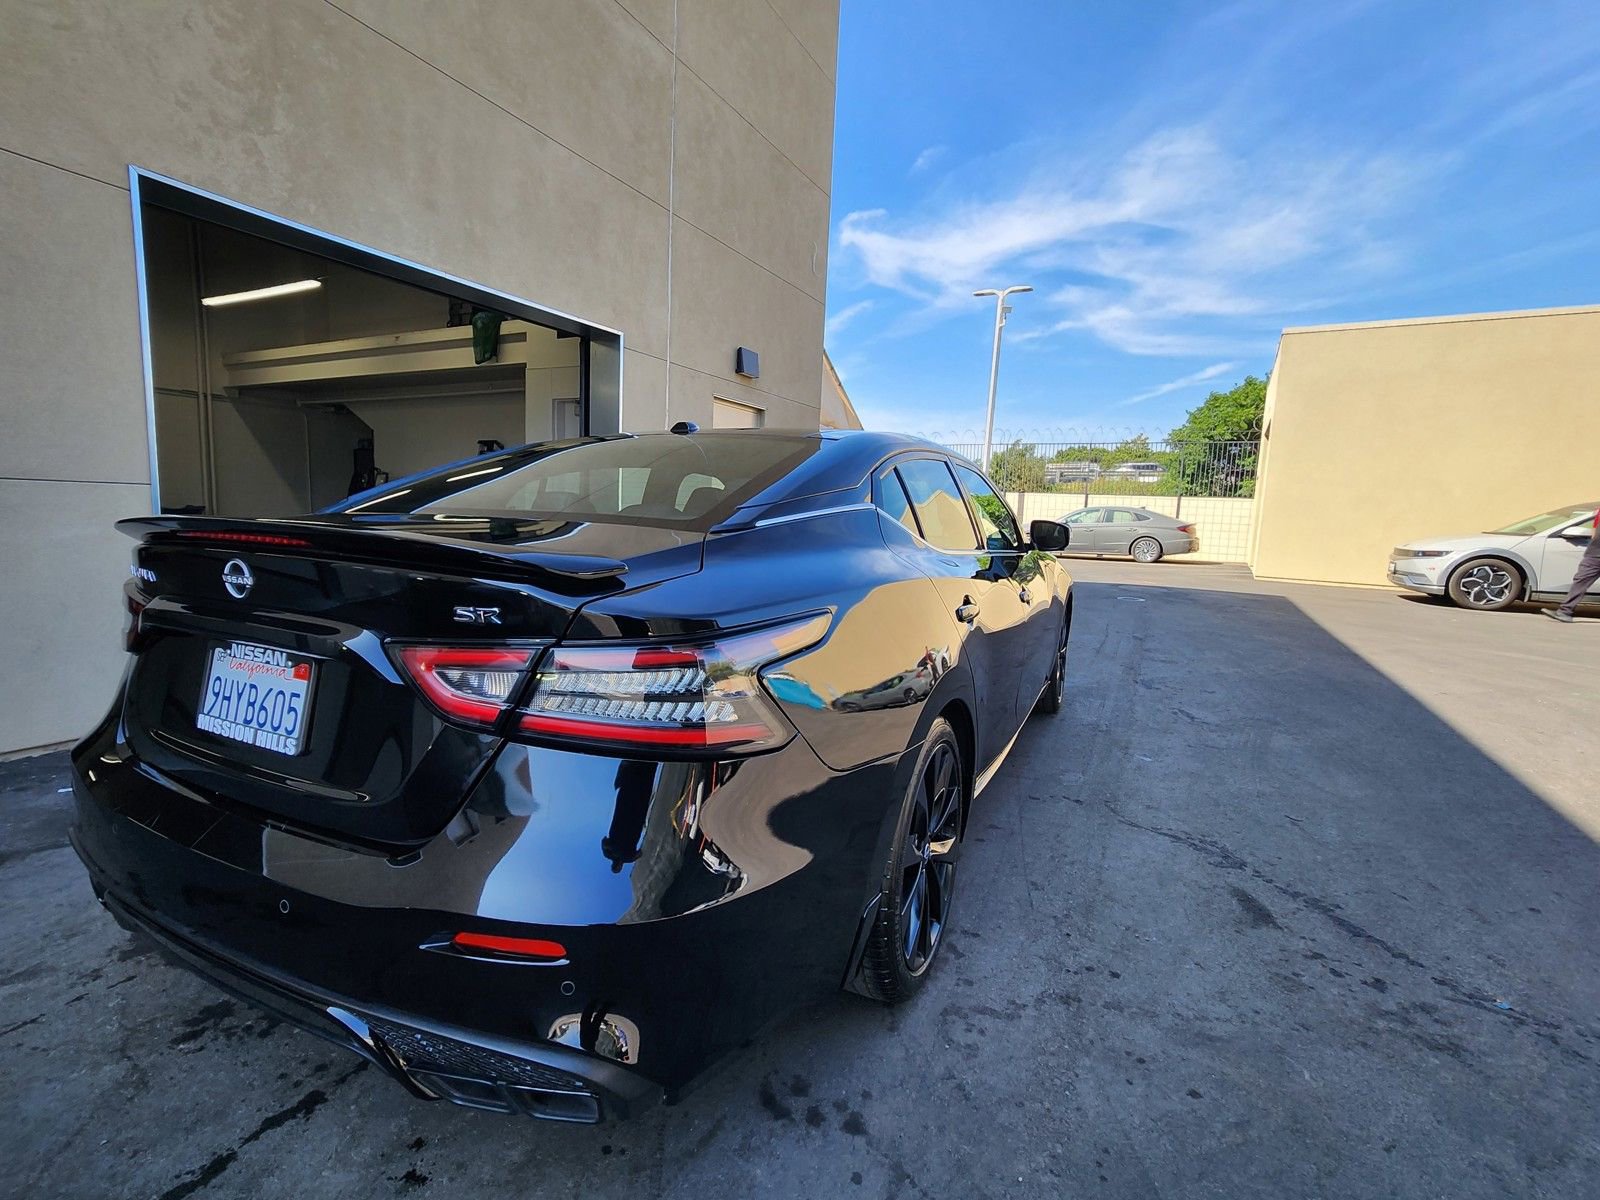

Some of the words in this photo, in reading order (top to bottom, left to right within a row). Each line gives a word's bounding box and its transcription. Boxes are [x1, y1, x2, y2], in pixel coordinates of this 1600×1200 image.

[231, 643, 287, 667] NISSAN
[206, 675, 301, 736] 9HYB605
[197, 713, 255, 745] MISSION
[255, 730, 297, 756] HILLS
